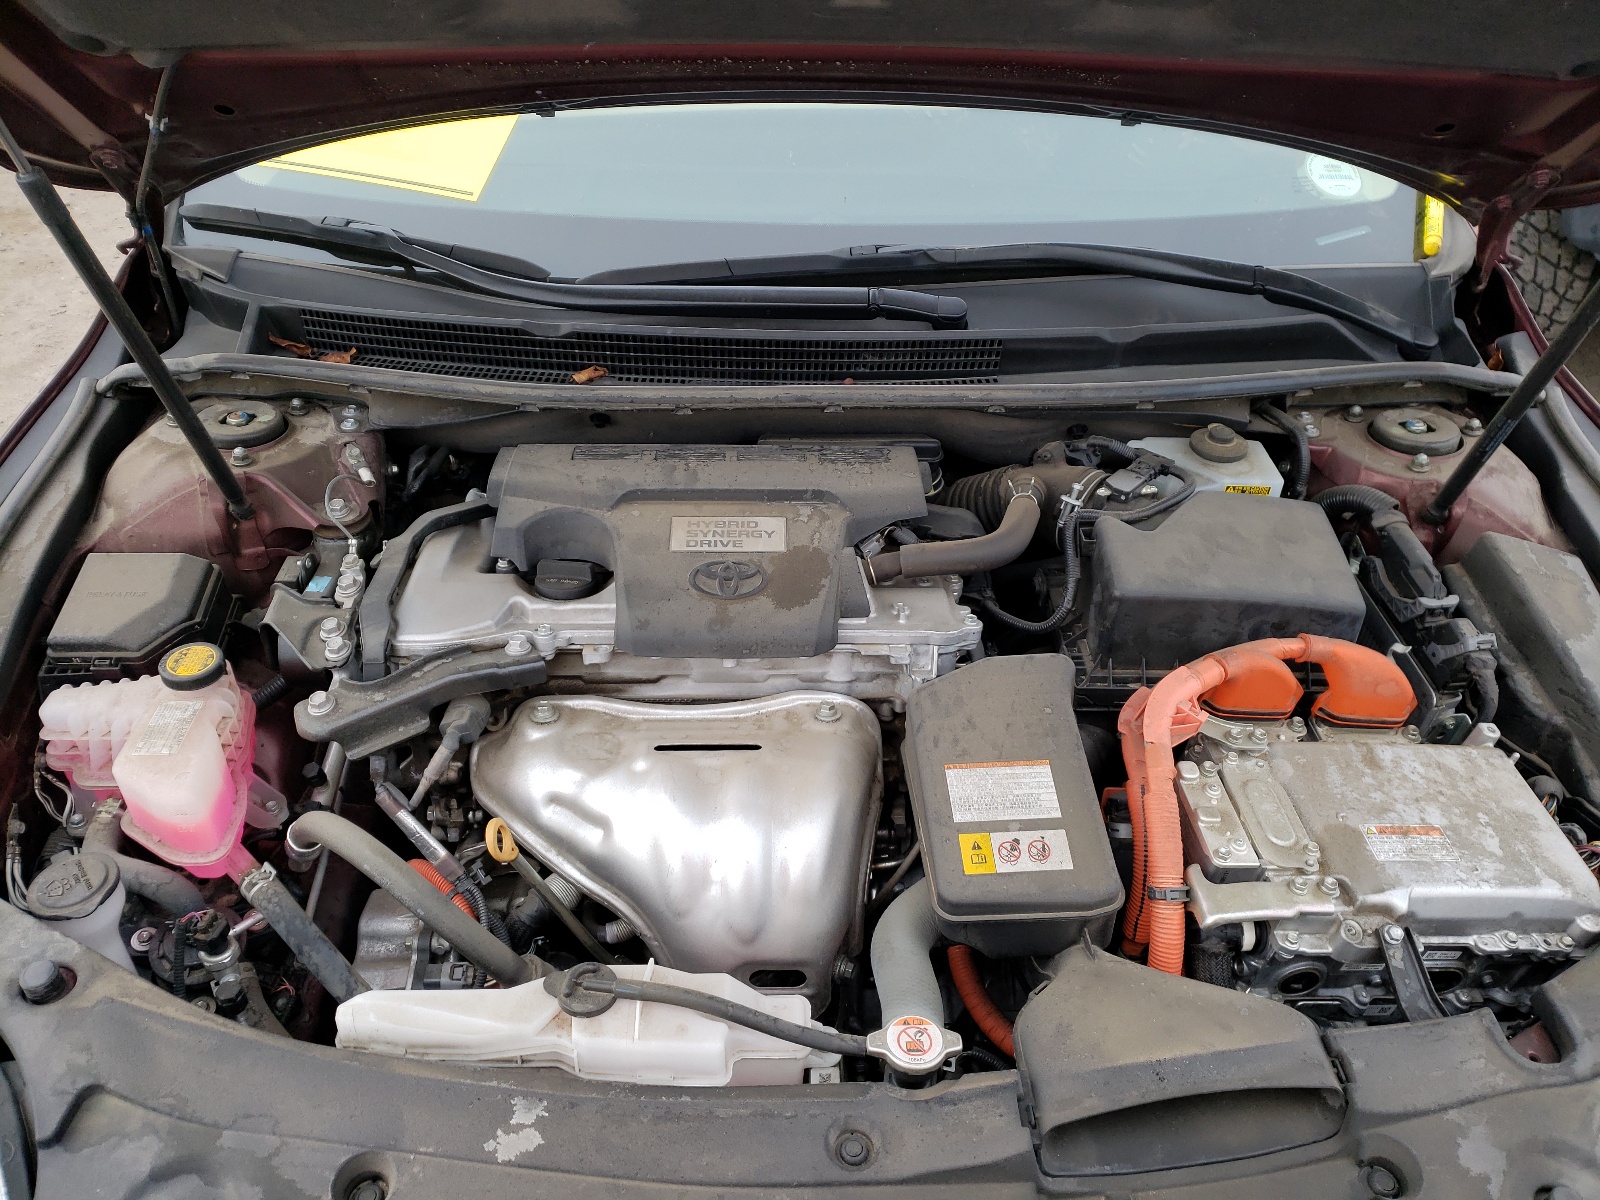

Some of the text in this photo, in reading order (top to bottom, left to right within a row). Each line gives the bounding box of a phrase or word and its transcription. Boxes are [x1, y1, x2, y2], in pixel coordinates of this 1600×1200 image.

[688, 520, 758, 528] HYBRID
[686, 530, 776, 538] SYNERGY
[685, 540, 744, 548] DRIVE
